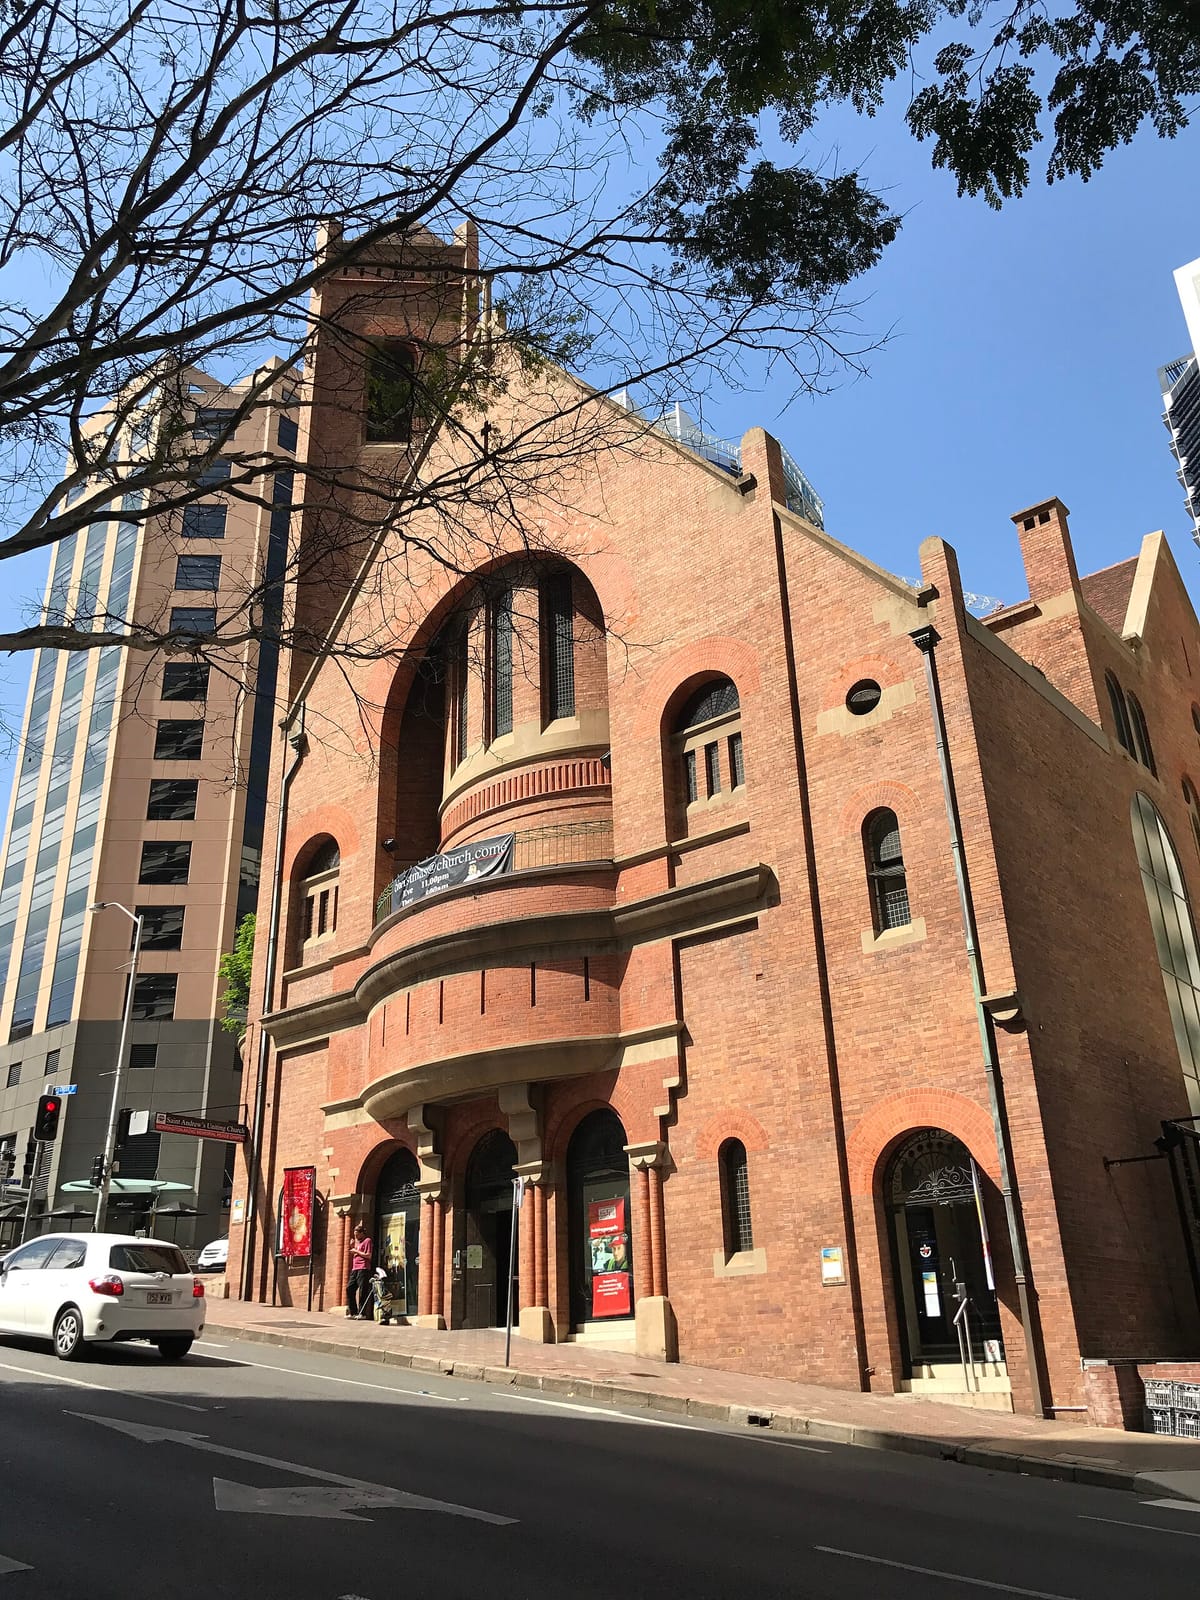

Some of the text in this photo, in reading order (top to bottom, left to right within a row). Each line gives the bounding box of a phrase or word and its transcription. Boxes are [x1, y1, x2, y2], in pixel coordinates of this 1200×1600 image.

[166, 1117, 245, 1134] Saint Andrew's Uniting Church
